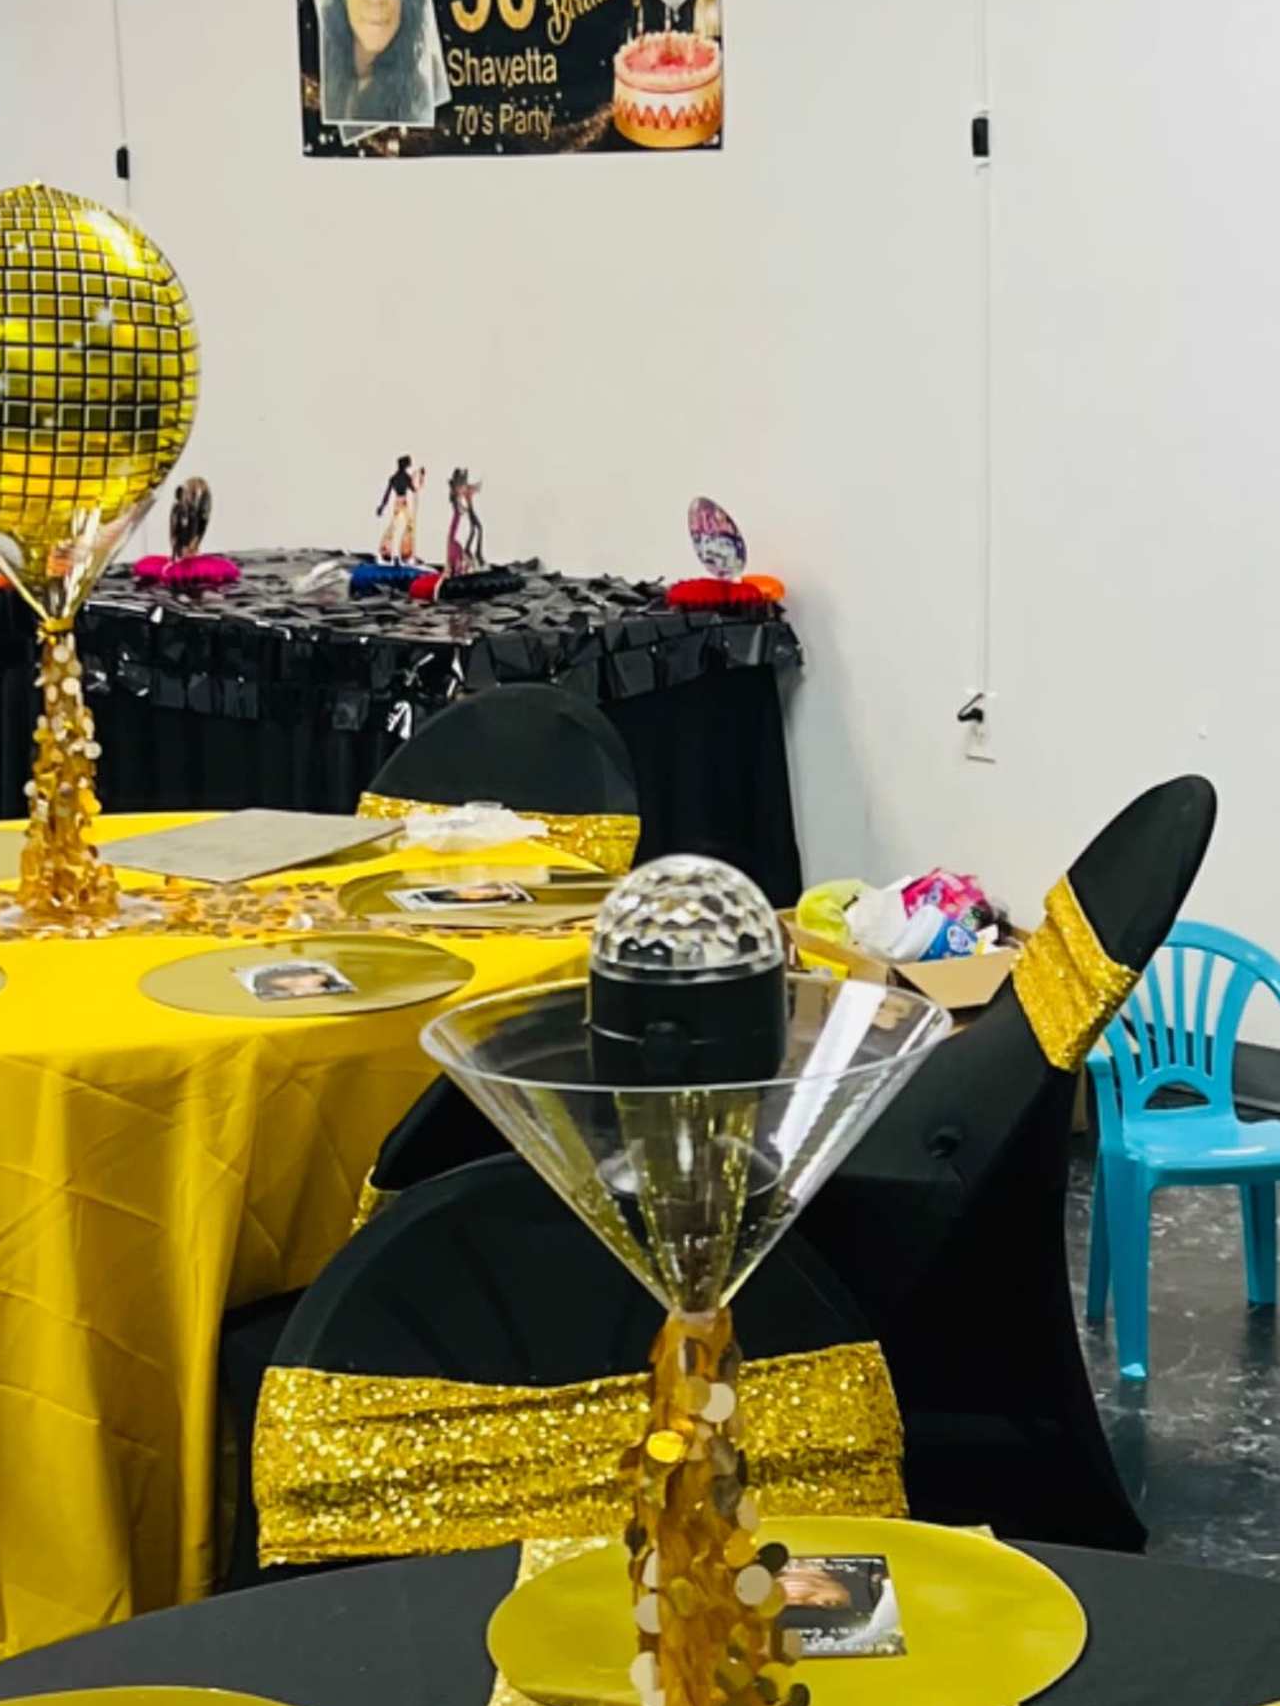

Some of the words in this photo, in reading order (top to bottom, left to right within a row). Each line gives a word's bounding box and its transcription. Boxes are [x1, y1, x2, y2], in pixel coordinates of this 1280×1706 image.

[447, 46, 558, 87] Shavetta
[454, 104, 495, 136] 70's
[499, 105, 554, 137] Party
